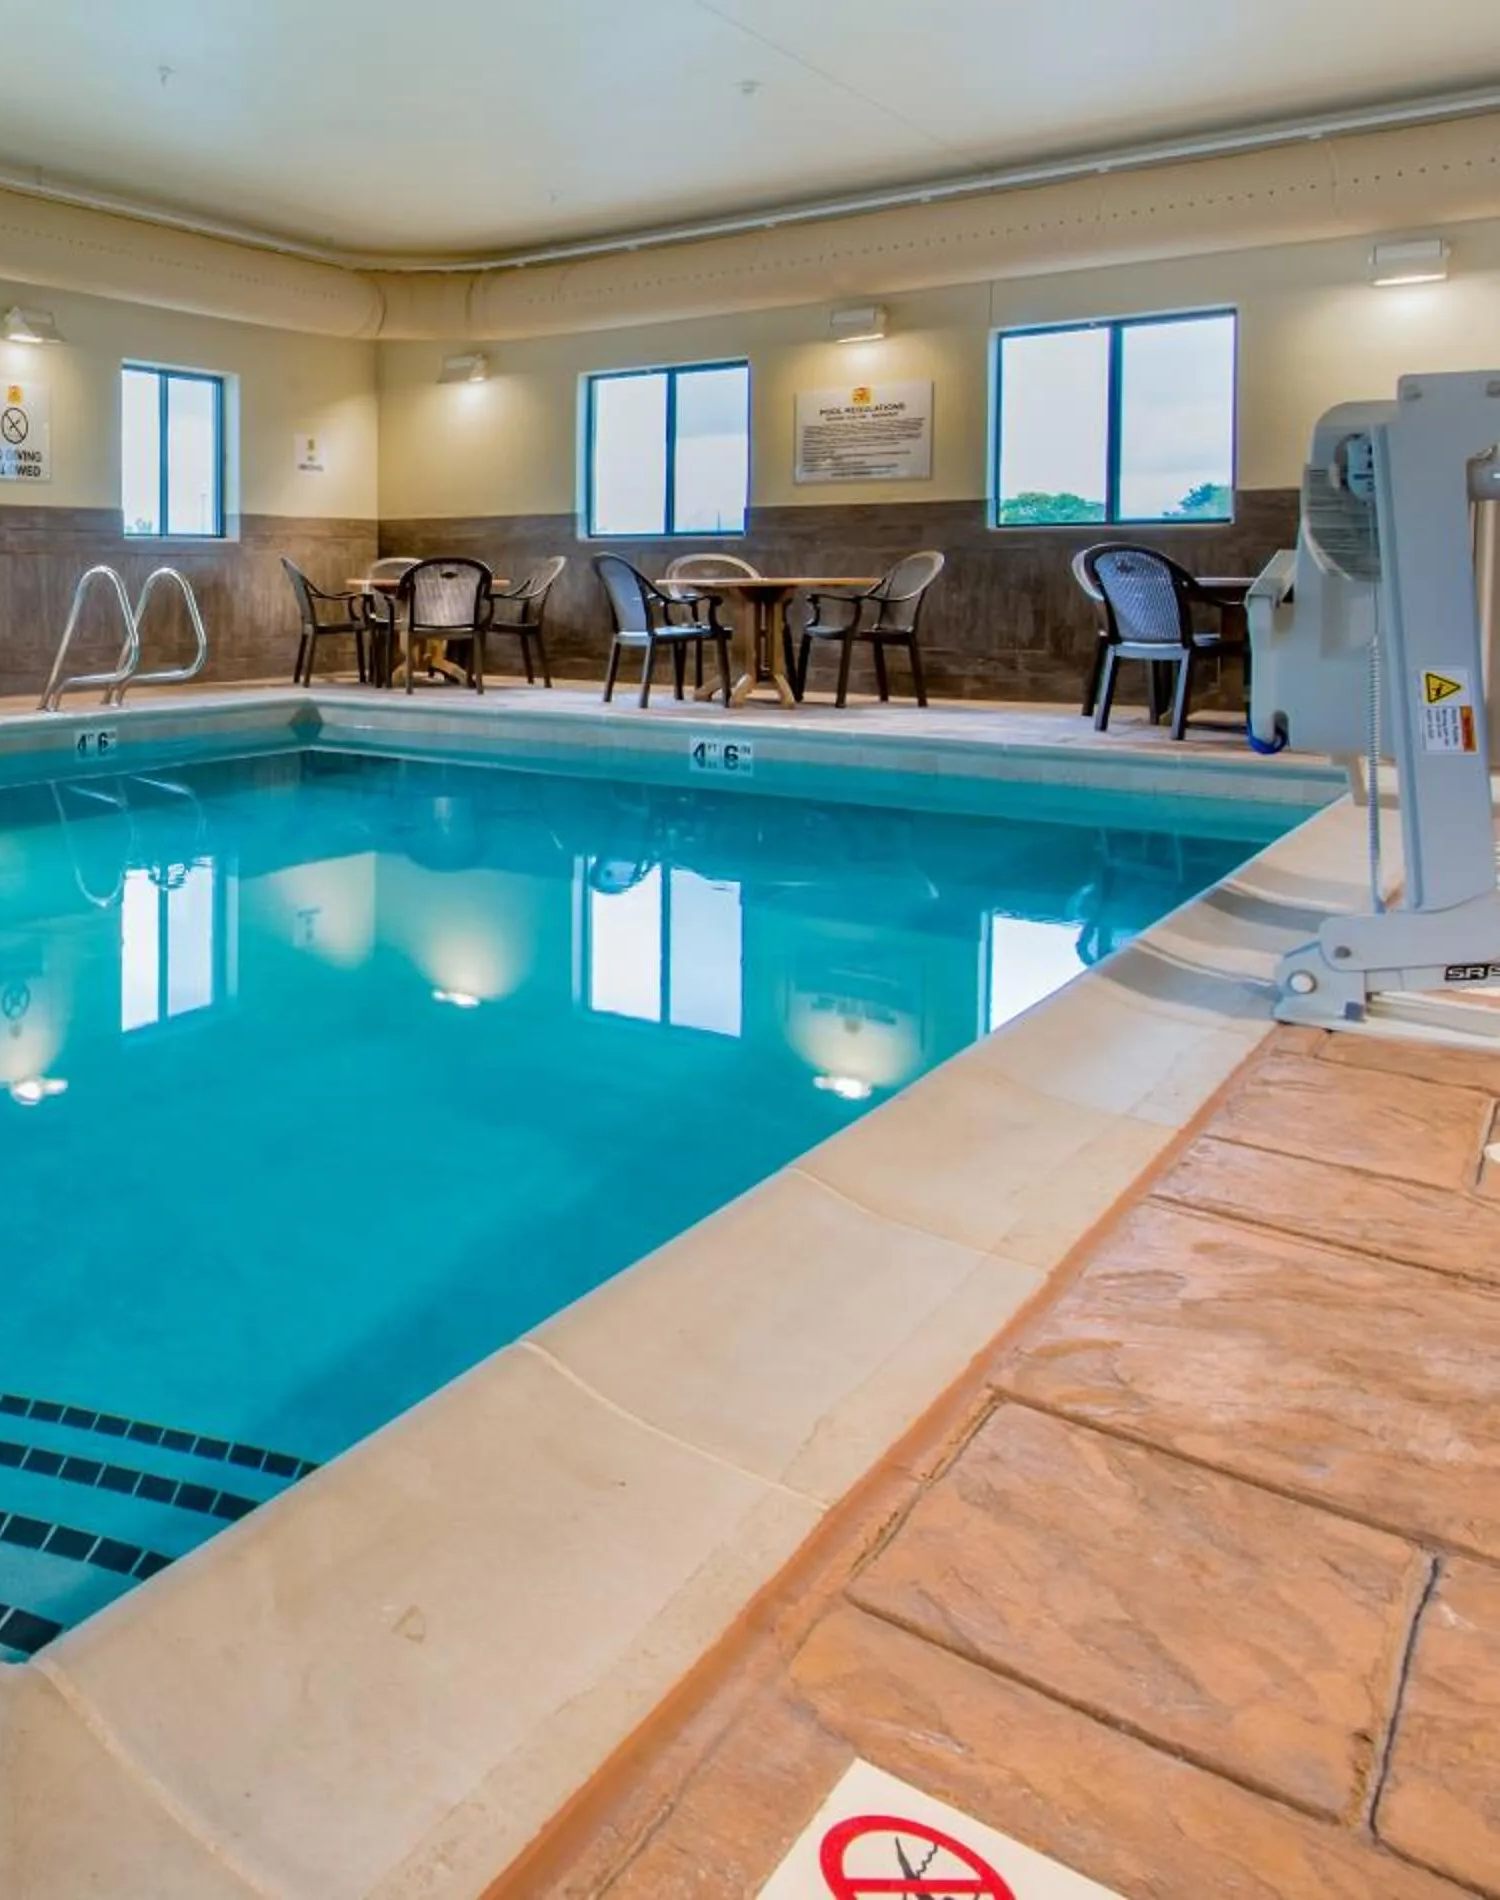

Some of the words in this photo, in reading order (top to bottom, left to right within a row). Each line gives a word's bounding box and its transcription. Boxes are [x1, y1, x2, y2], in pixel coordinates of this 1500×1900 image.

[98, 731, 109, 751] 6
[693, 742, 705, 760] 4
[724, 745, 739, 762] 6
